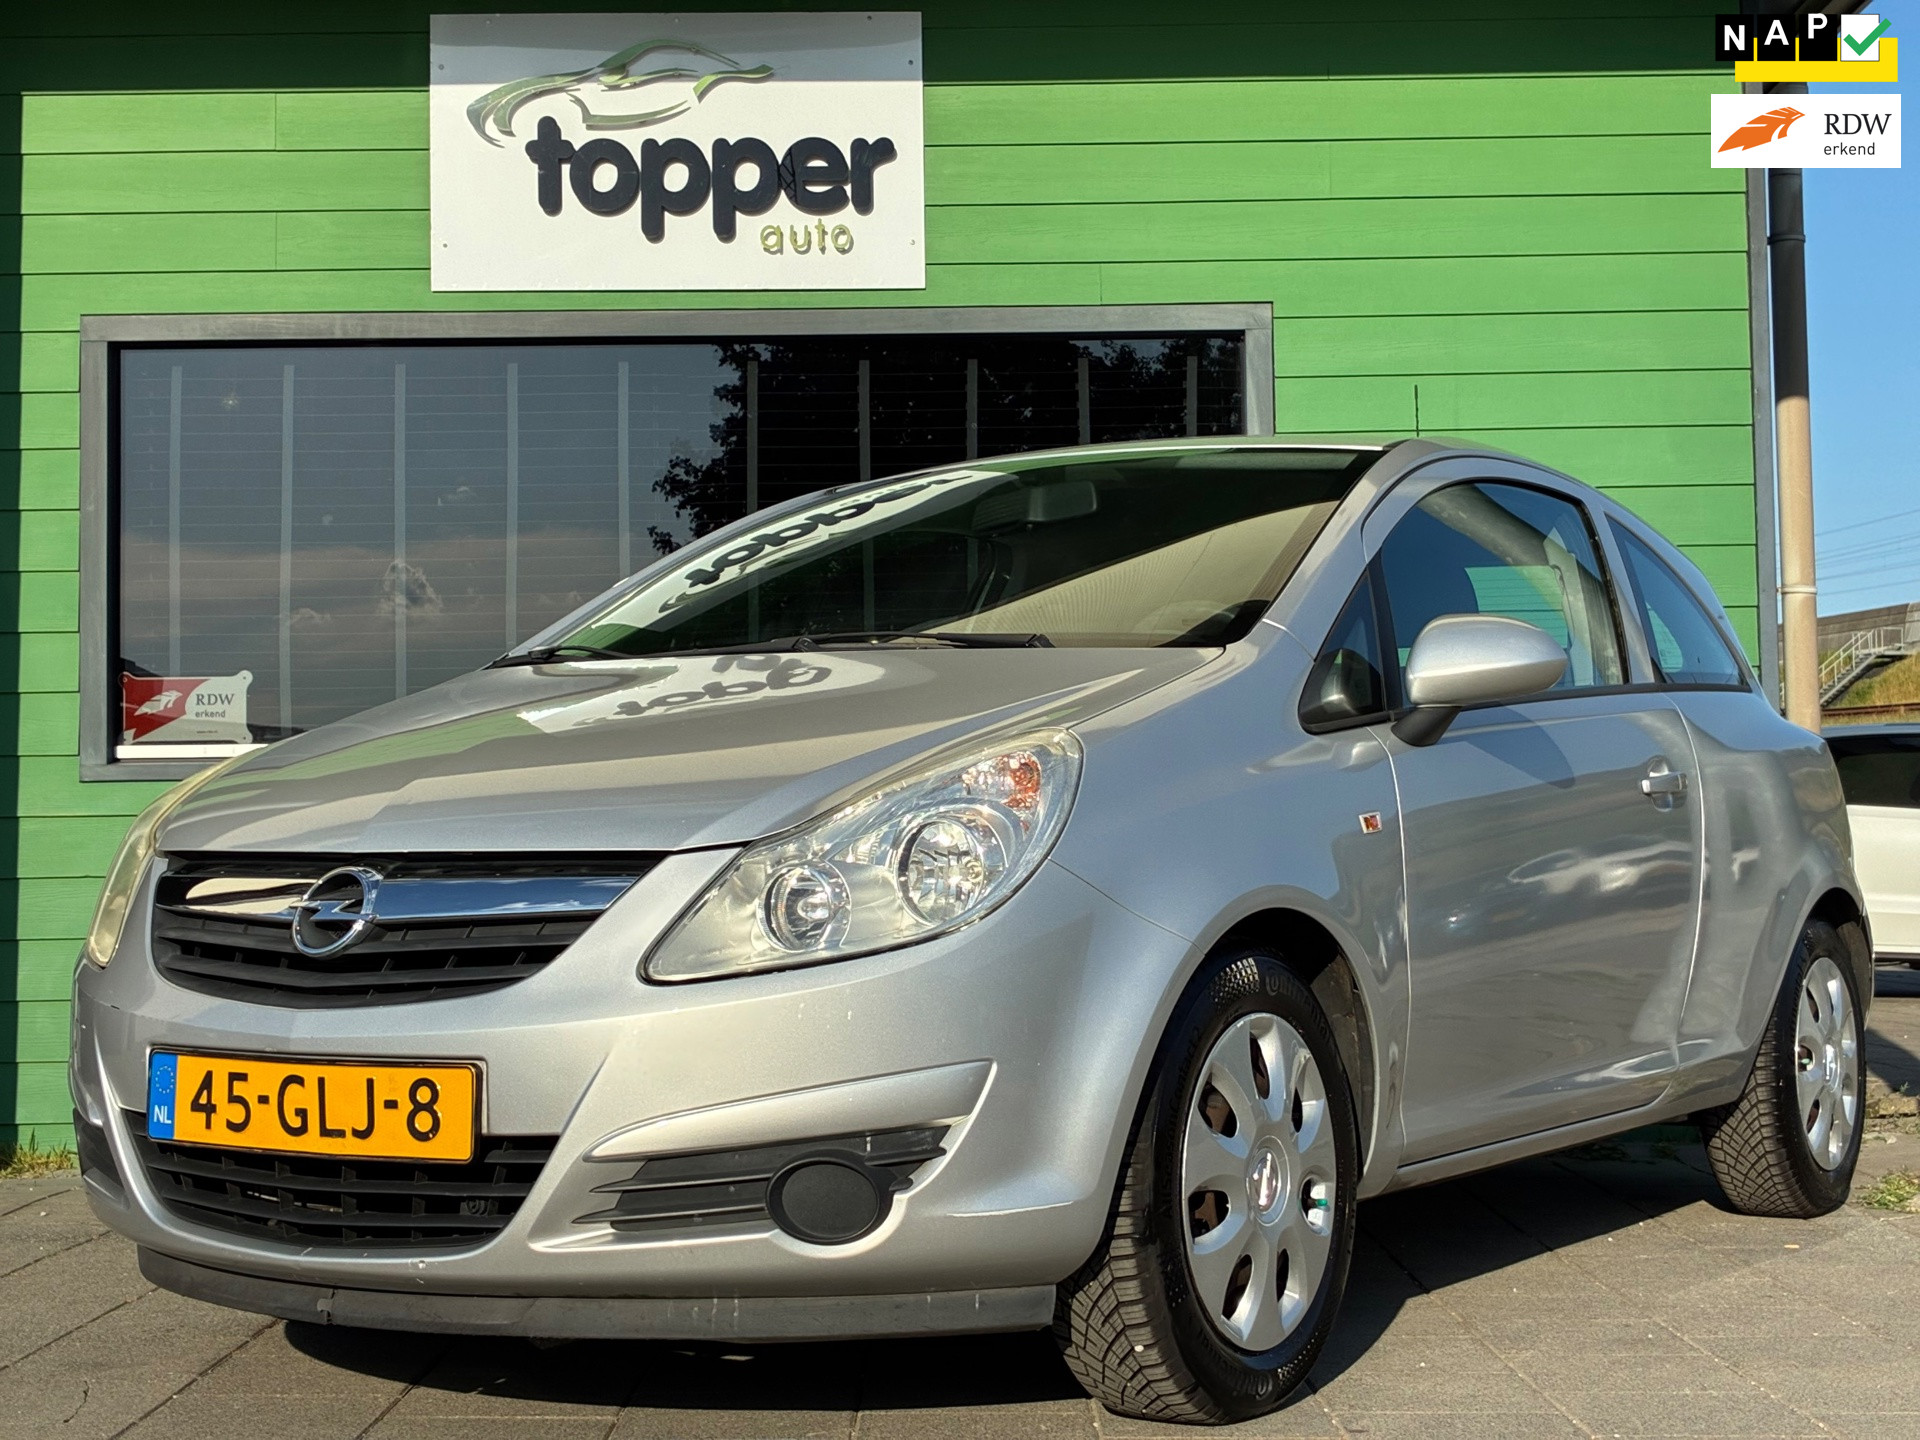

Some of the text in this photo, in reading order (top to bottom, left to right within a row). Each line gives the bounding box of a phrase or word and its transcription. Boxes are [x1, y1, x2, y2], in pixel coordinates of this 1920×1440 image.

[525, 115, 897, 243] topper
[760, 218, 854, 255] auto
[195, 693, 235, 706] RDW
[195, 709, 226, 718] erkend
[153, 1104, 172, 1124] NL
[190, 1069, 442, 1142] 45-GLJ-8
